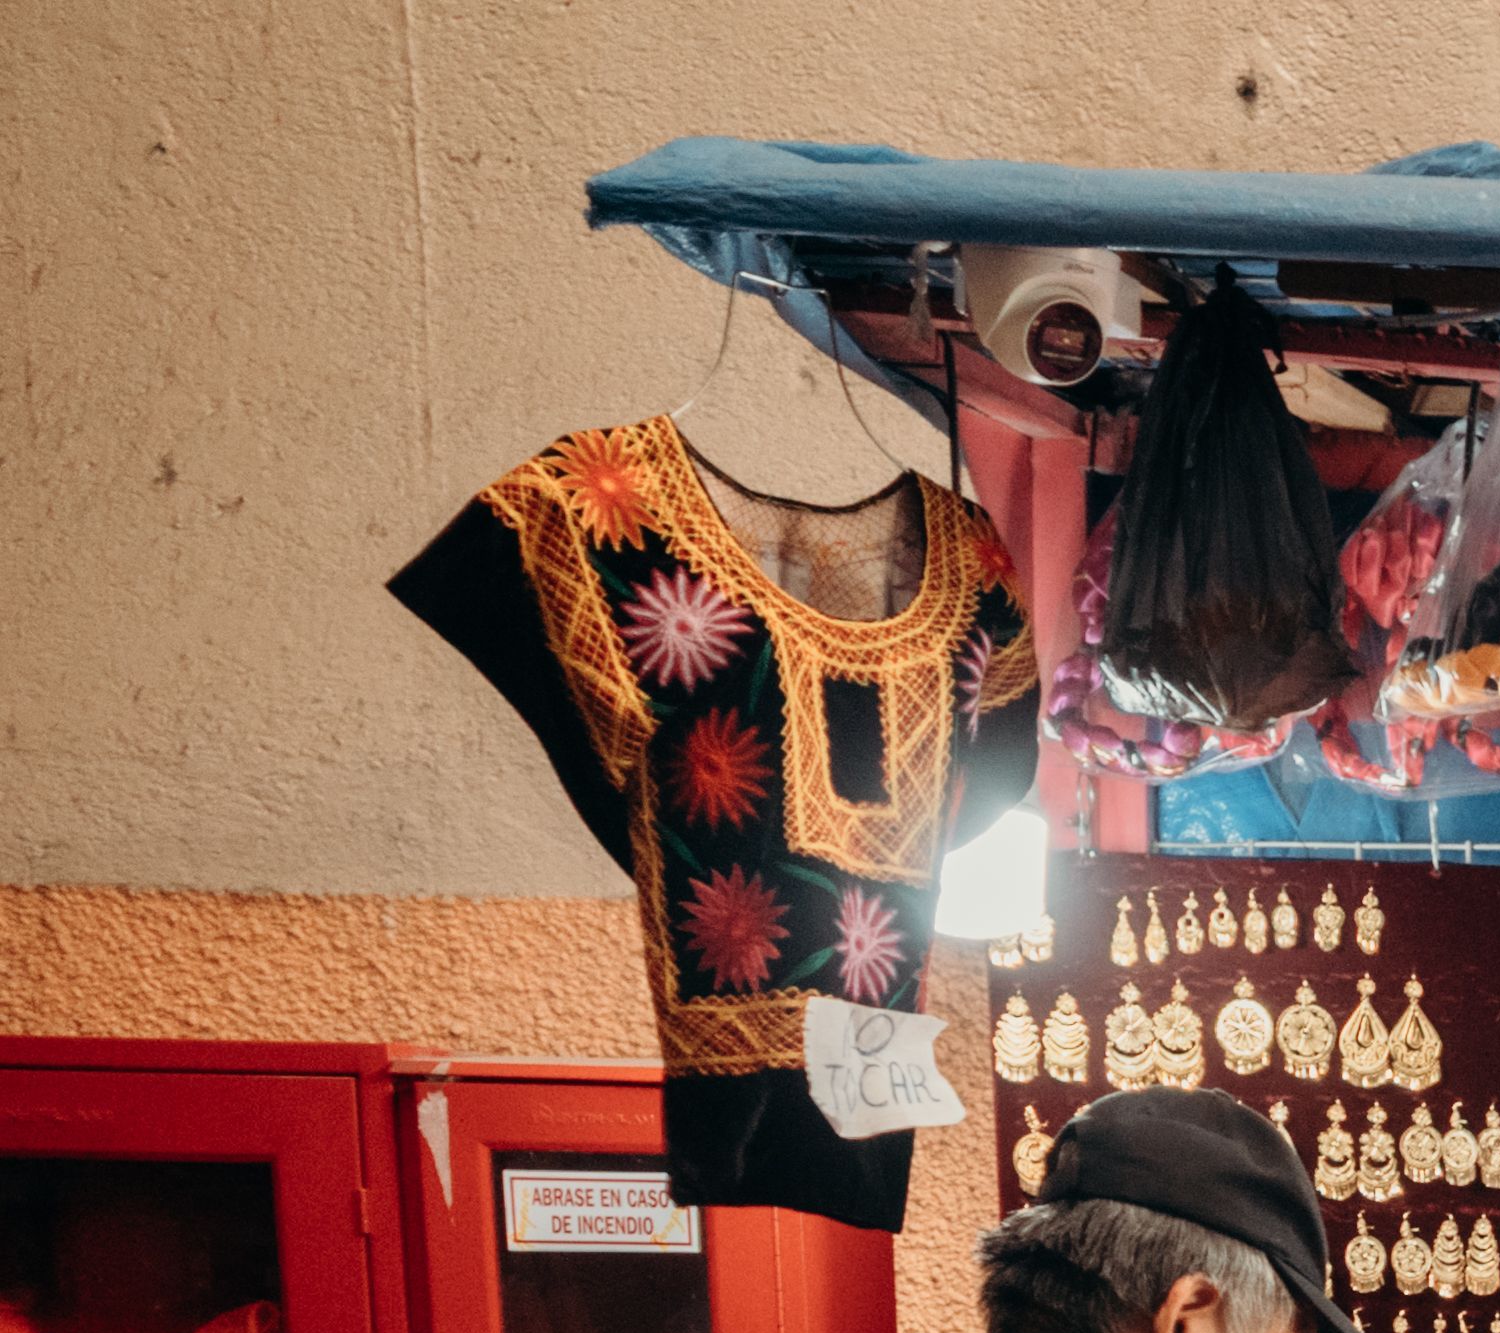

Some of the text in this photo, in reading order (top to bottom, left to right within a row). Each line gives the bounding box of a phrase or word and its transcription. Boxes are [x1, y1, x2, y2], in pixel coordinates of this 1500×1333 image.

[531, 1187, 670, 1208] ABRASE EN CASO
[551, 1215, 573, 1234] DE
[577, 1216, 655, 1236] INCENDIO
